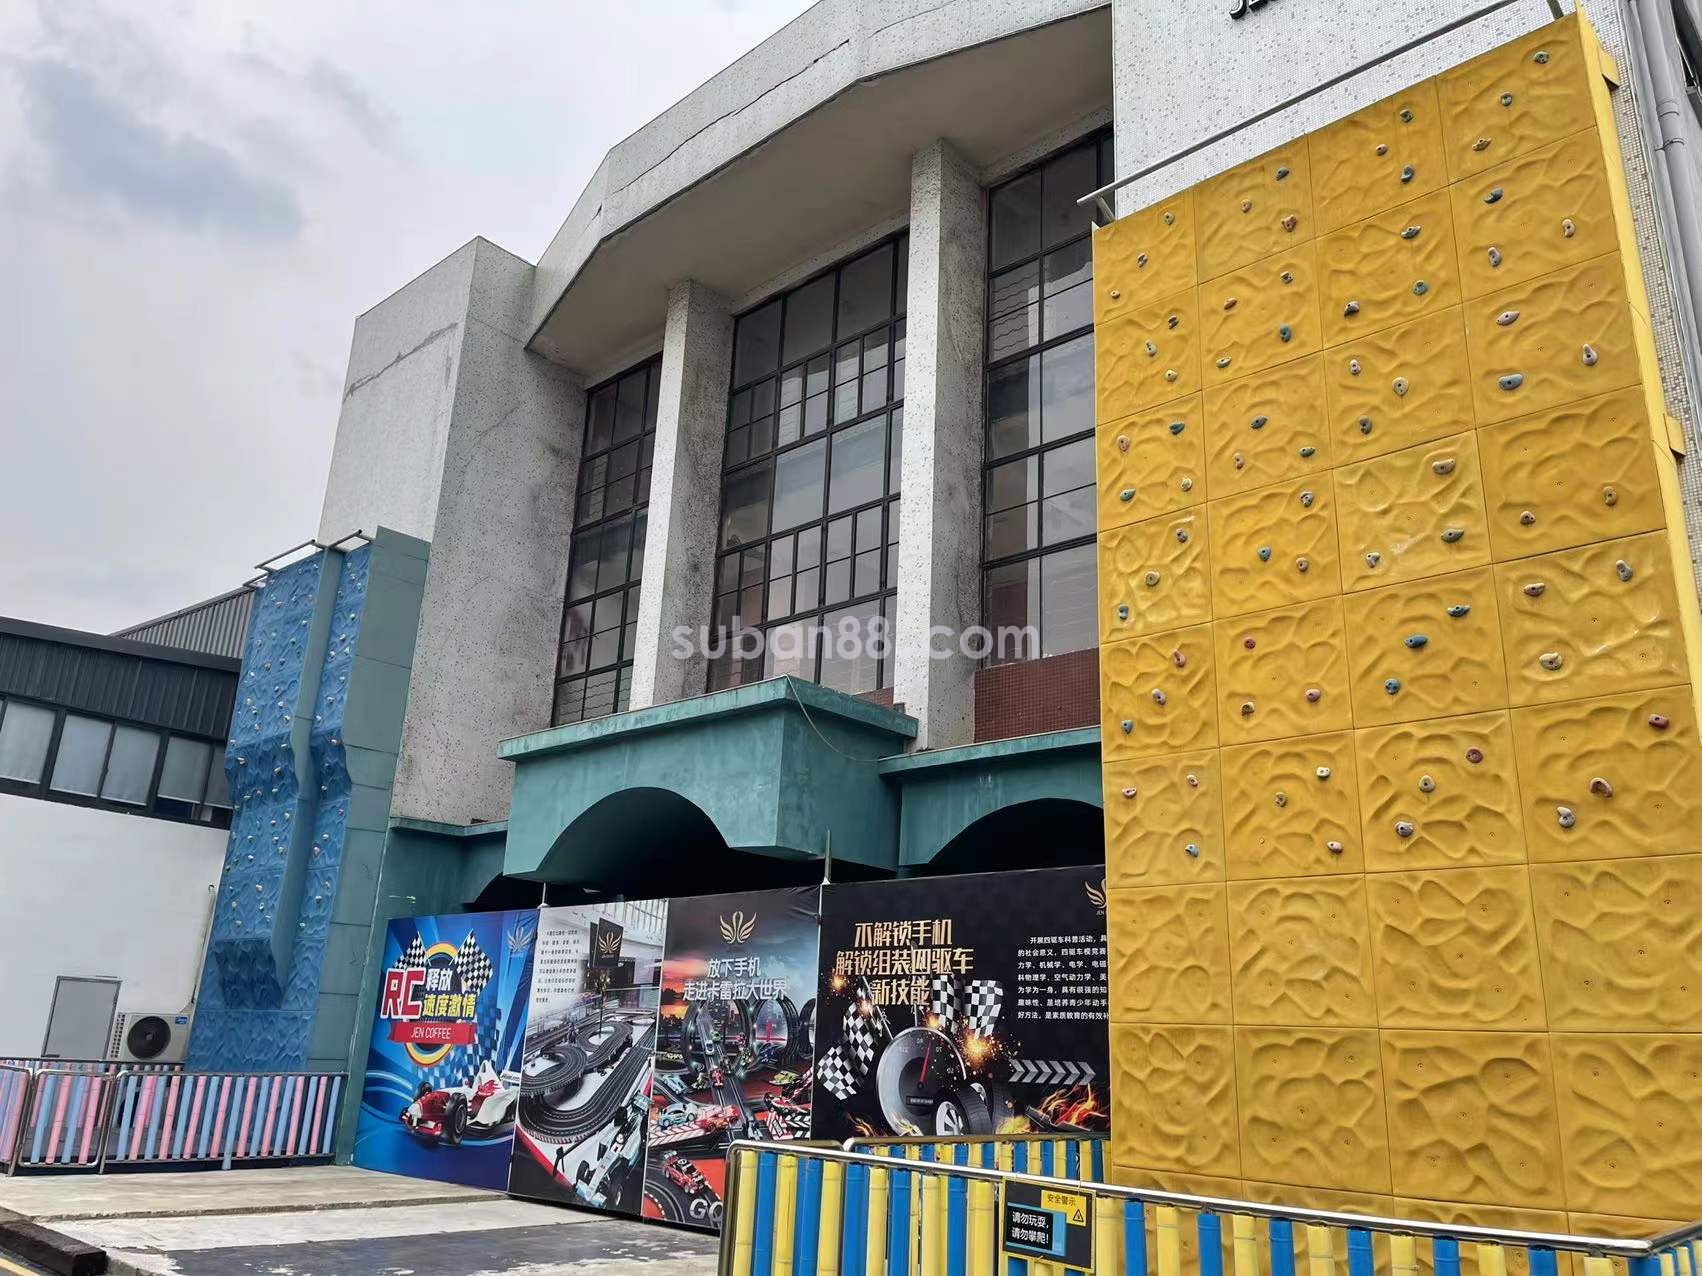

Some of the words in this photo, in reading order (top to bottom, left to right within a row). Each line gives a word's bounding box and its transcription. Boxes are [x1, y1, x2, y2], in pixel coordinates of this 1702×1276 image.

[855, 919, 952, 948] 不解锁手机
[707, 957, 761, 978] 放下手机
[835, 948, 974, 976] 解锁组装四驱车
[426, 968, 453, 991] 释放
[682, 979, 788, 1001] 走进卡雷拉大世界
[872, 975, 930, 1006] 新技能
[380, 967, 426, 1019] RC
[422, 994, 477, 1018] 速度激情
[411, 1027, 425, 1039] JEN
[425, 1027, 452, 1040] COFFEE
[1047, 1193, 1076, 1206] 安全警示
